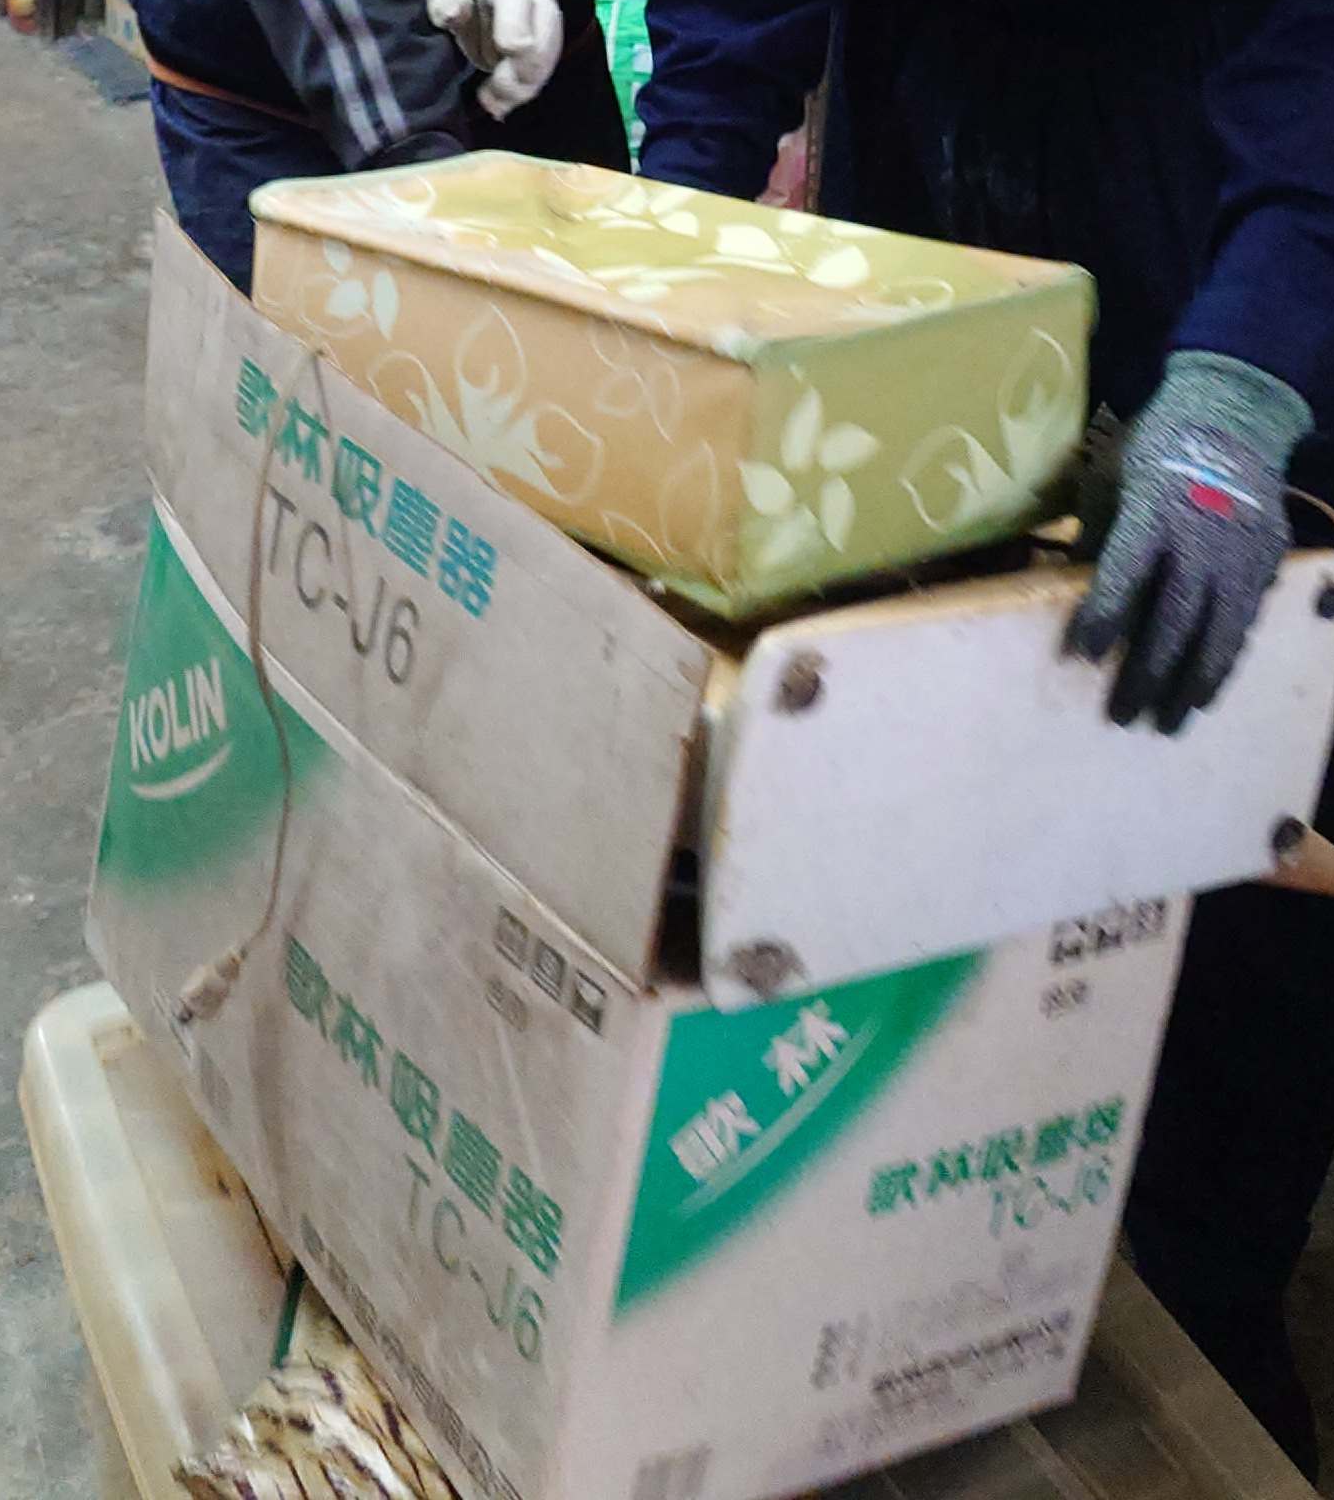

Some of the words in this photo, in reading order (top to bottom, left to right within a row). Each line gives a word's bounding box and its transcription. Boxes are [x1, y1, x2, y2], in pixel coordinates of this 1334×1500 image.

[234, 355, 498, 620] 歌林吸塵器
[266, 482, 420, 685] TC-J6
[128, 656, 228, 773] KOLIN
[285, 931, 564, 1282] 歌林吸塵器
[403, 1151, 548, 1364] TC-J6
